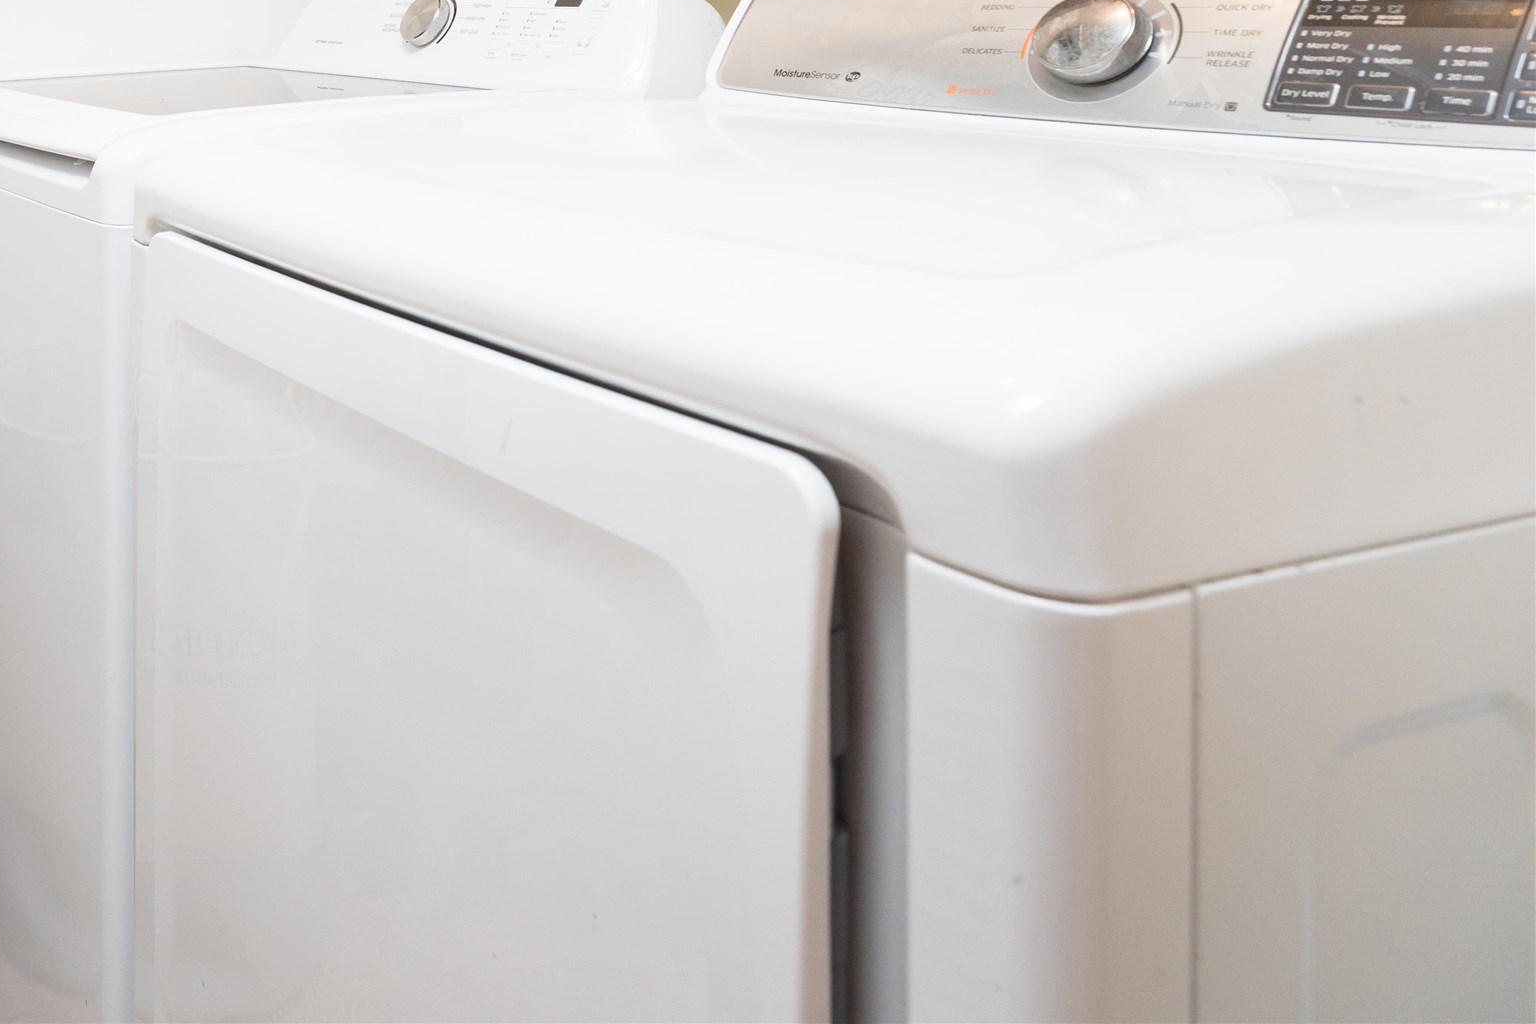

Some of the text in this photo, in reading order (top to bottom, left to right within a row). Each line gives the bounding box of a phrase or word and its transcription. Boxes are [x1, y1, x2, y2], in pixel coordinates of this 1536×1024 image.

[980, 4, 1016, 12] BEDDING
[1216, 3, 1274, 12] QUICK DRY
[971, 25, 1007, 33] SANITIZE
[1213, 29, 1264, 37] TIME DRY
[1311, 29, 1352, 38] Very Dry
[961, 47, 1004, 56] DELICATES
[1306, 42, 1350, 52] More Dry
[1377, 43, 1402, 53] High
[1472, 45, 1494, 53] min
[1207, 50, 1255, 59] WRINKLE
[1205, 59, 1251, 68] RELEASE
[1302, 55, 1355, 65] Normal Dry
[1373, 57, 1414, 65] Medium
[1468, 59, 1490, 67] min
[1296, 68, 1344, 78] Damp Dry
[1369, 70, 1390, 79] Low
[1463, 73, 1485, 82] min
[1281, 88, 1330, 99] Dry Level
[1442, 96, 1473, 106] Time
